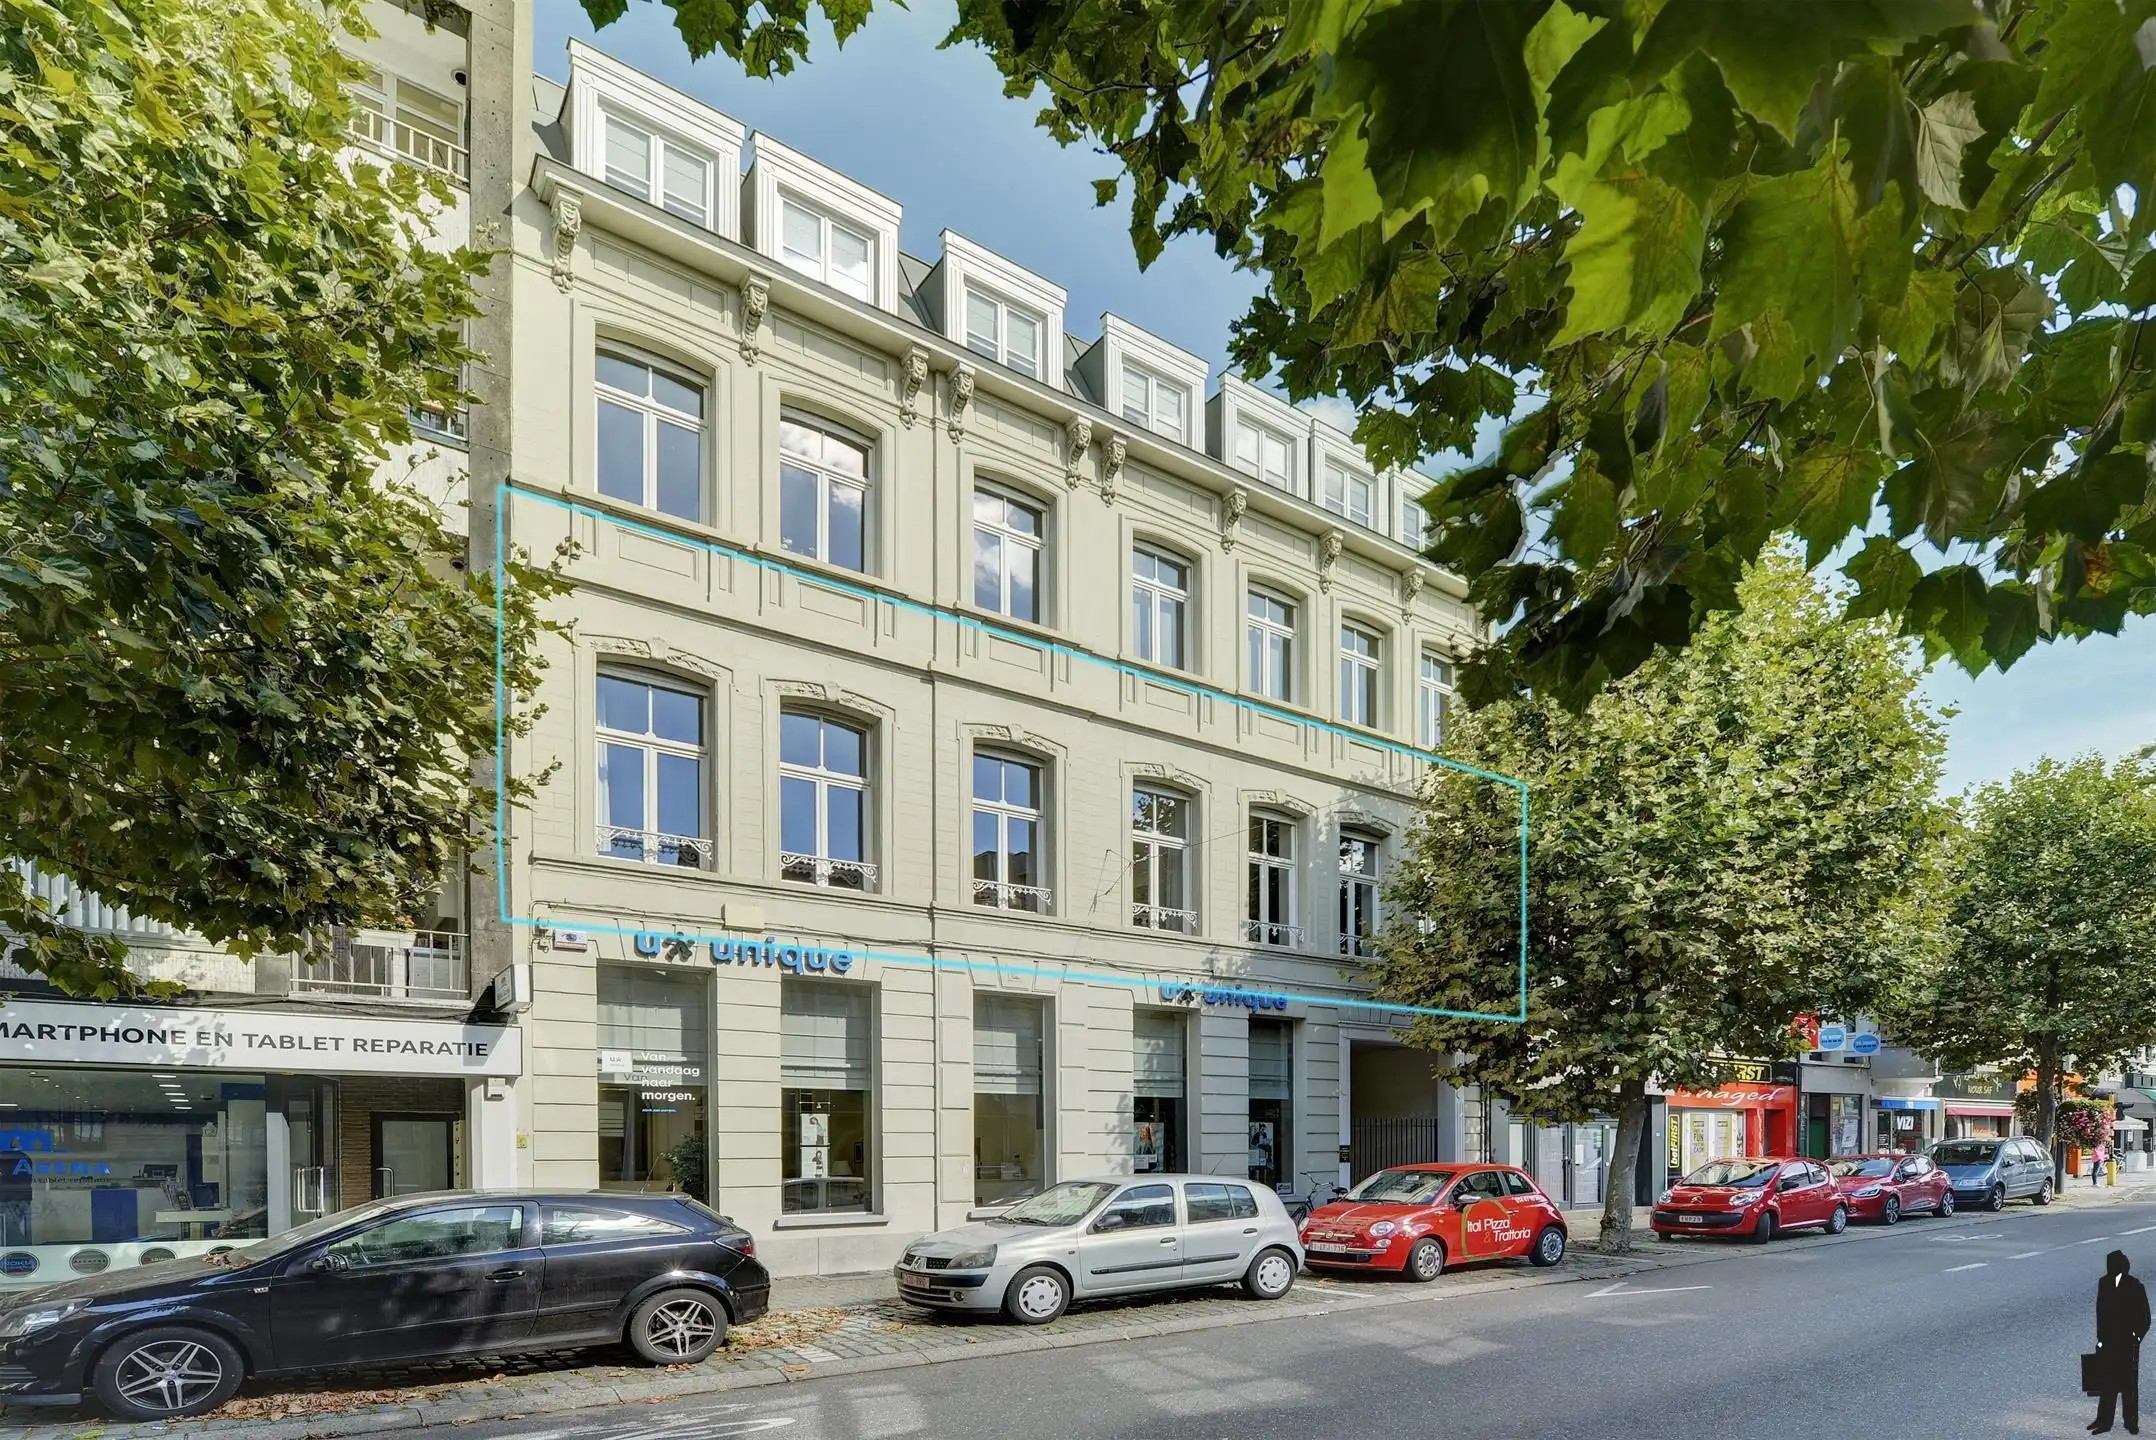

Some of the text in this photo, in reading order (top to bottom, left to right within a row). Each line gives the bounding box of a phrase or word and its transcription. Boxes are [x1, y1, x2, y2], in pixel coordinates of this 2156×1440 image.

[709, 936, 854, 975] unique
[1201, 984, 1288, 1013] unique
[197, 1031, 233, 1048] EN
[242, 1033, 345, 1051] TABLET
[353, 1038, 489, 1057] REPARATIE
[641, 1051, 667, 1062] Van
[641, 1065, 700, 1077] vandaag
[641, 1079, 673, 1088] naar
[641, 1091, 696, 1102] morgen.
[1671, 1119, 1679, 1165] betFIRST
[1467, 1218, 1511, 1233] Ital Pizza
[1493, 1227, 1531, 1243] Trattoria
